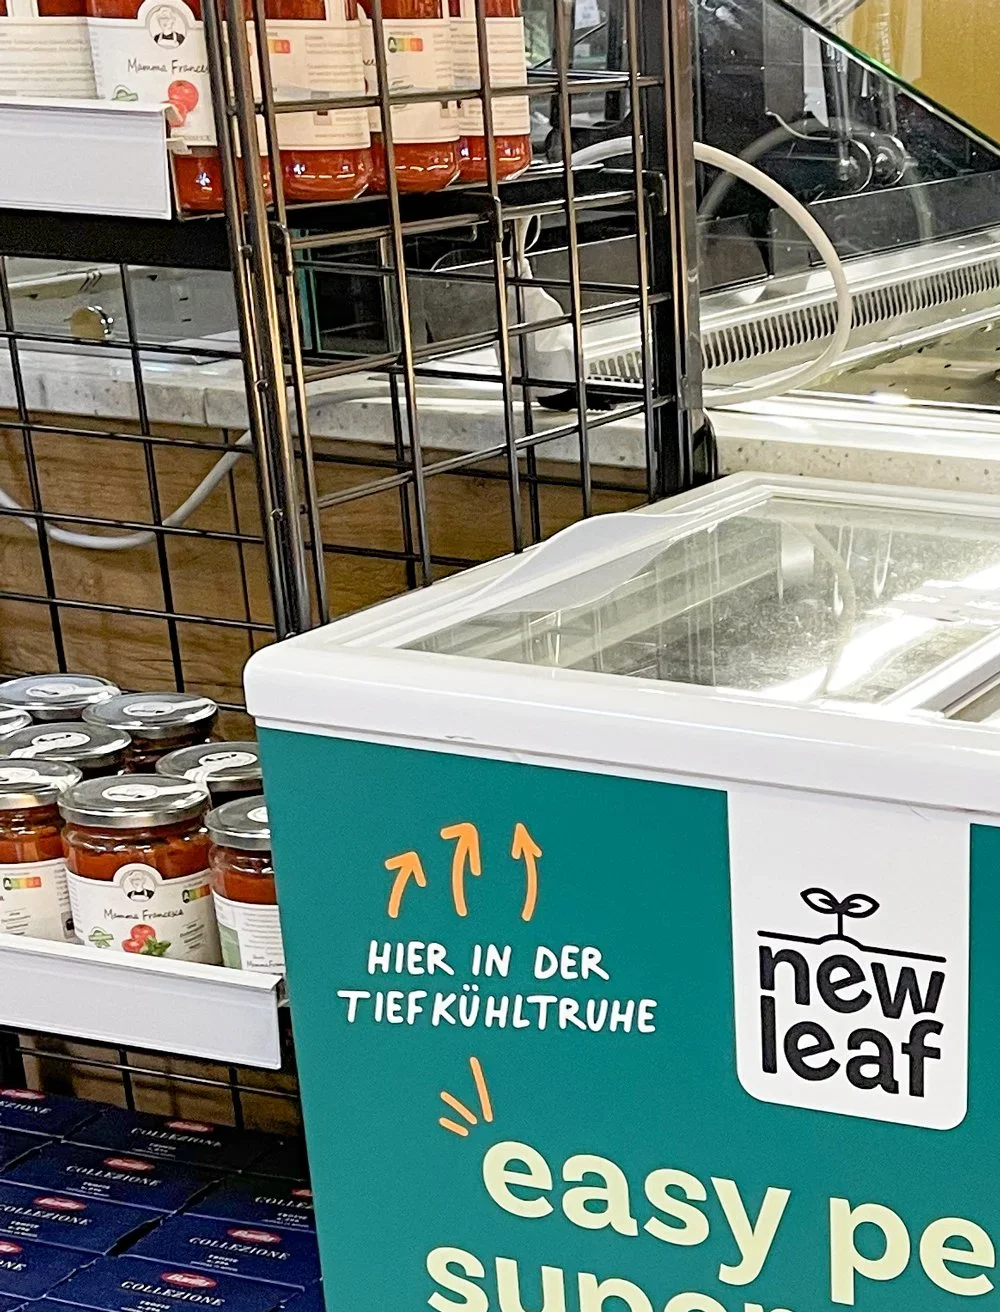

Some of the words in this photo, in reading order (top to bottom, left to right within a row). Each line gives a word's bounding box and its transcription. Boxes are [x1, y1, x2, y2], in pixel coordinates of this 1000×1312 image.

[128, 58, 167, 74] Mamma
[104, 909, 139, 920] Mamma
[366, 939, 455, 977] HIER
[472, 945, 511, 979] IN
[533, 945, 610, 982] DER
[758, 945, 946, 1019] new
[337, 984, 658, 1034] TIEFKÜHLTRUHE
[759, 994, 943, 1097] leaf
[482, 1139, 791, 1286] easy
[189, 1237, 291, 1261] COLLEZIONE
[121, 1280, 226, 1307] COLLEZIONE
